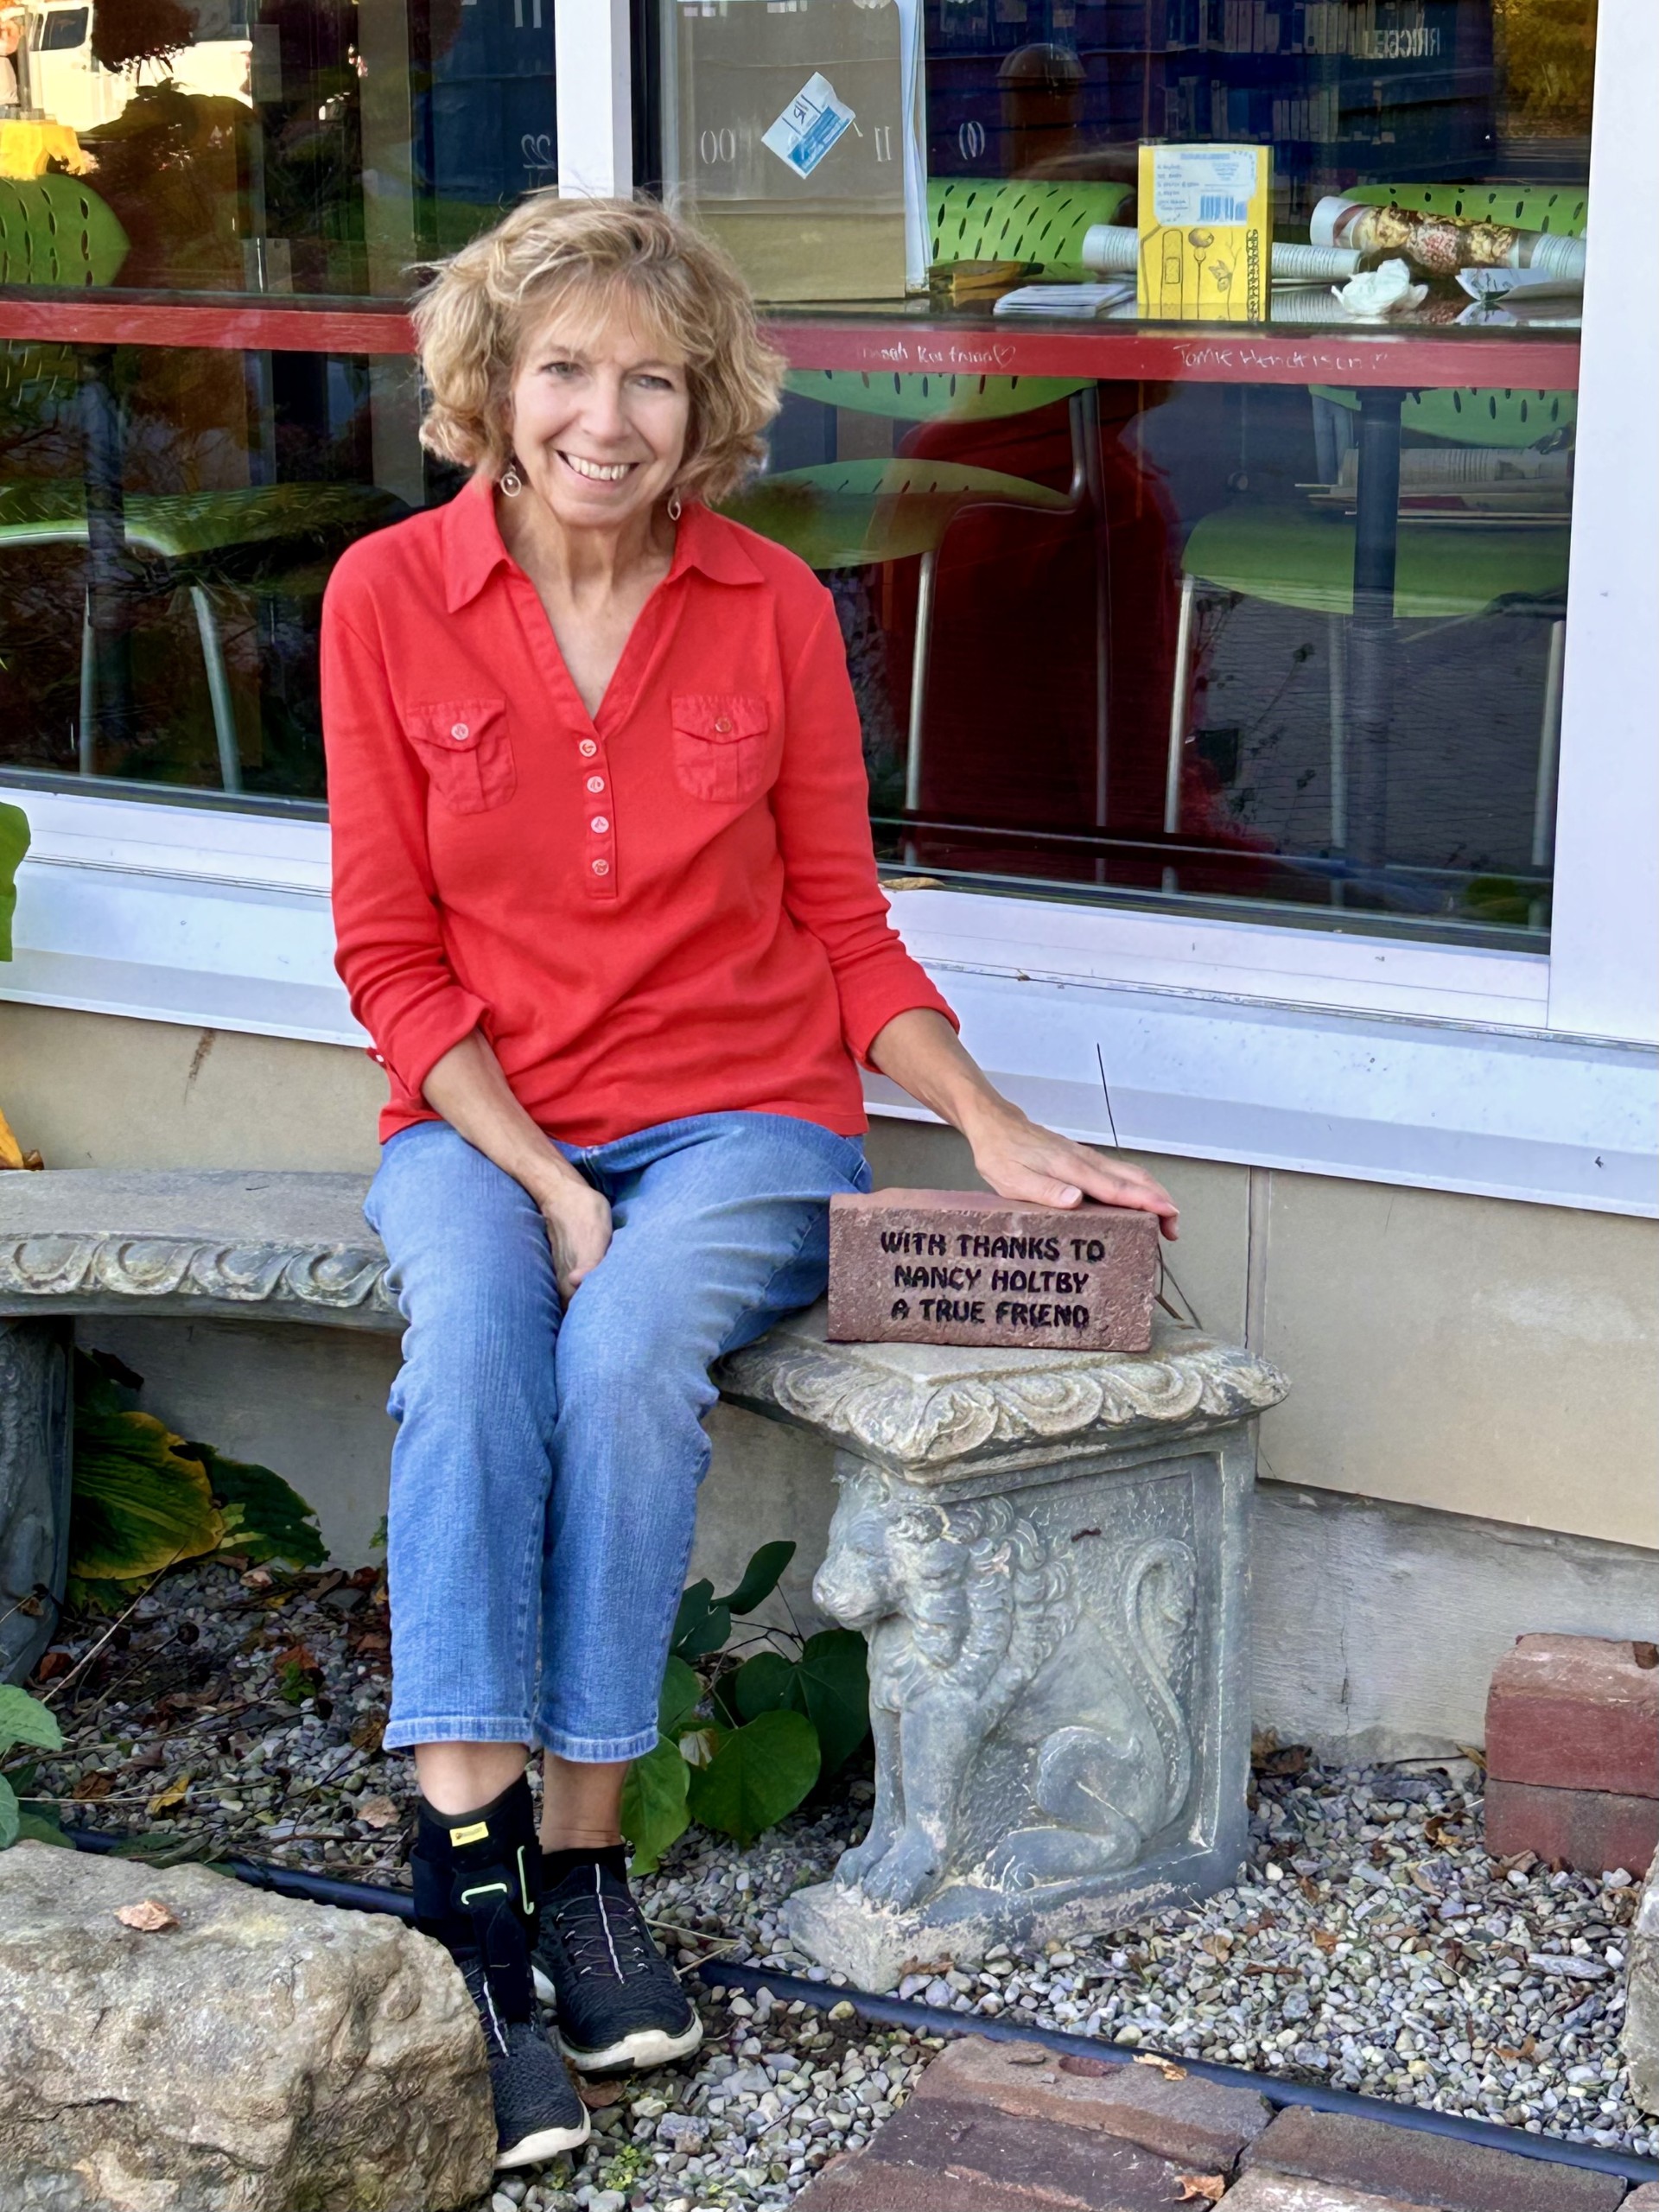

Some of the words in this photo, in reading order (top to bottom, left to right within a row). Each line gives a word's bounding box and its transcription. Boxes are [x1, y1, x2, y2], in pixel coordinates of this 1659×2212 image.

[880, 1231, 946, 1256] WITH
[957, 1233, 1061, 1261] THANKS
[1069, 1238, 1106, 1262] TO
[893, 1266, 982, 1291] NANCY
[990, 1268, 1090, 1294] HOLTBY
[890, 1298, 911, 1321] A
[918, 1299, 986, 1324] TRUE
[995, 1300, 1090, 1328] FRIEND
